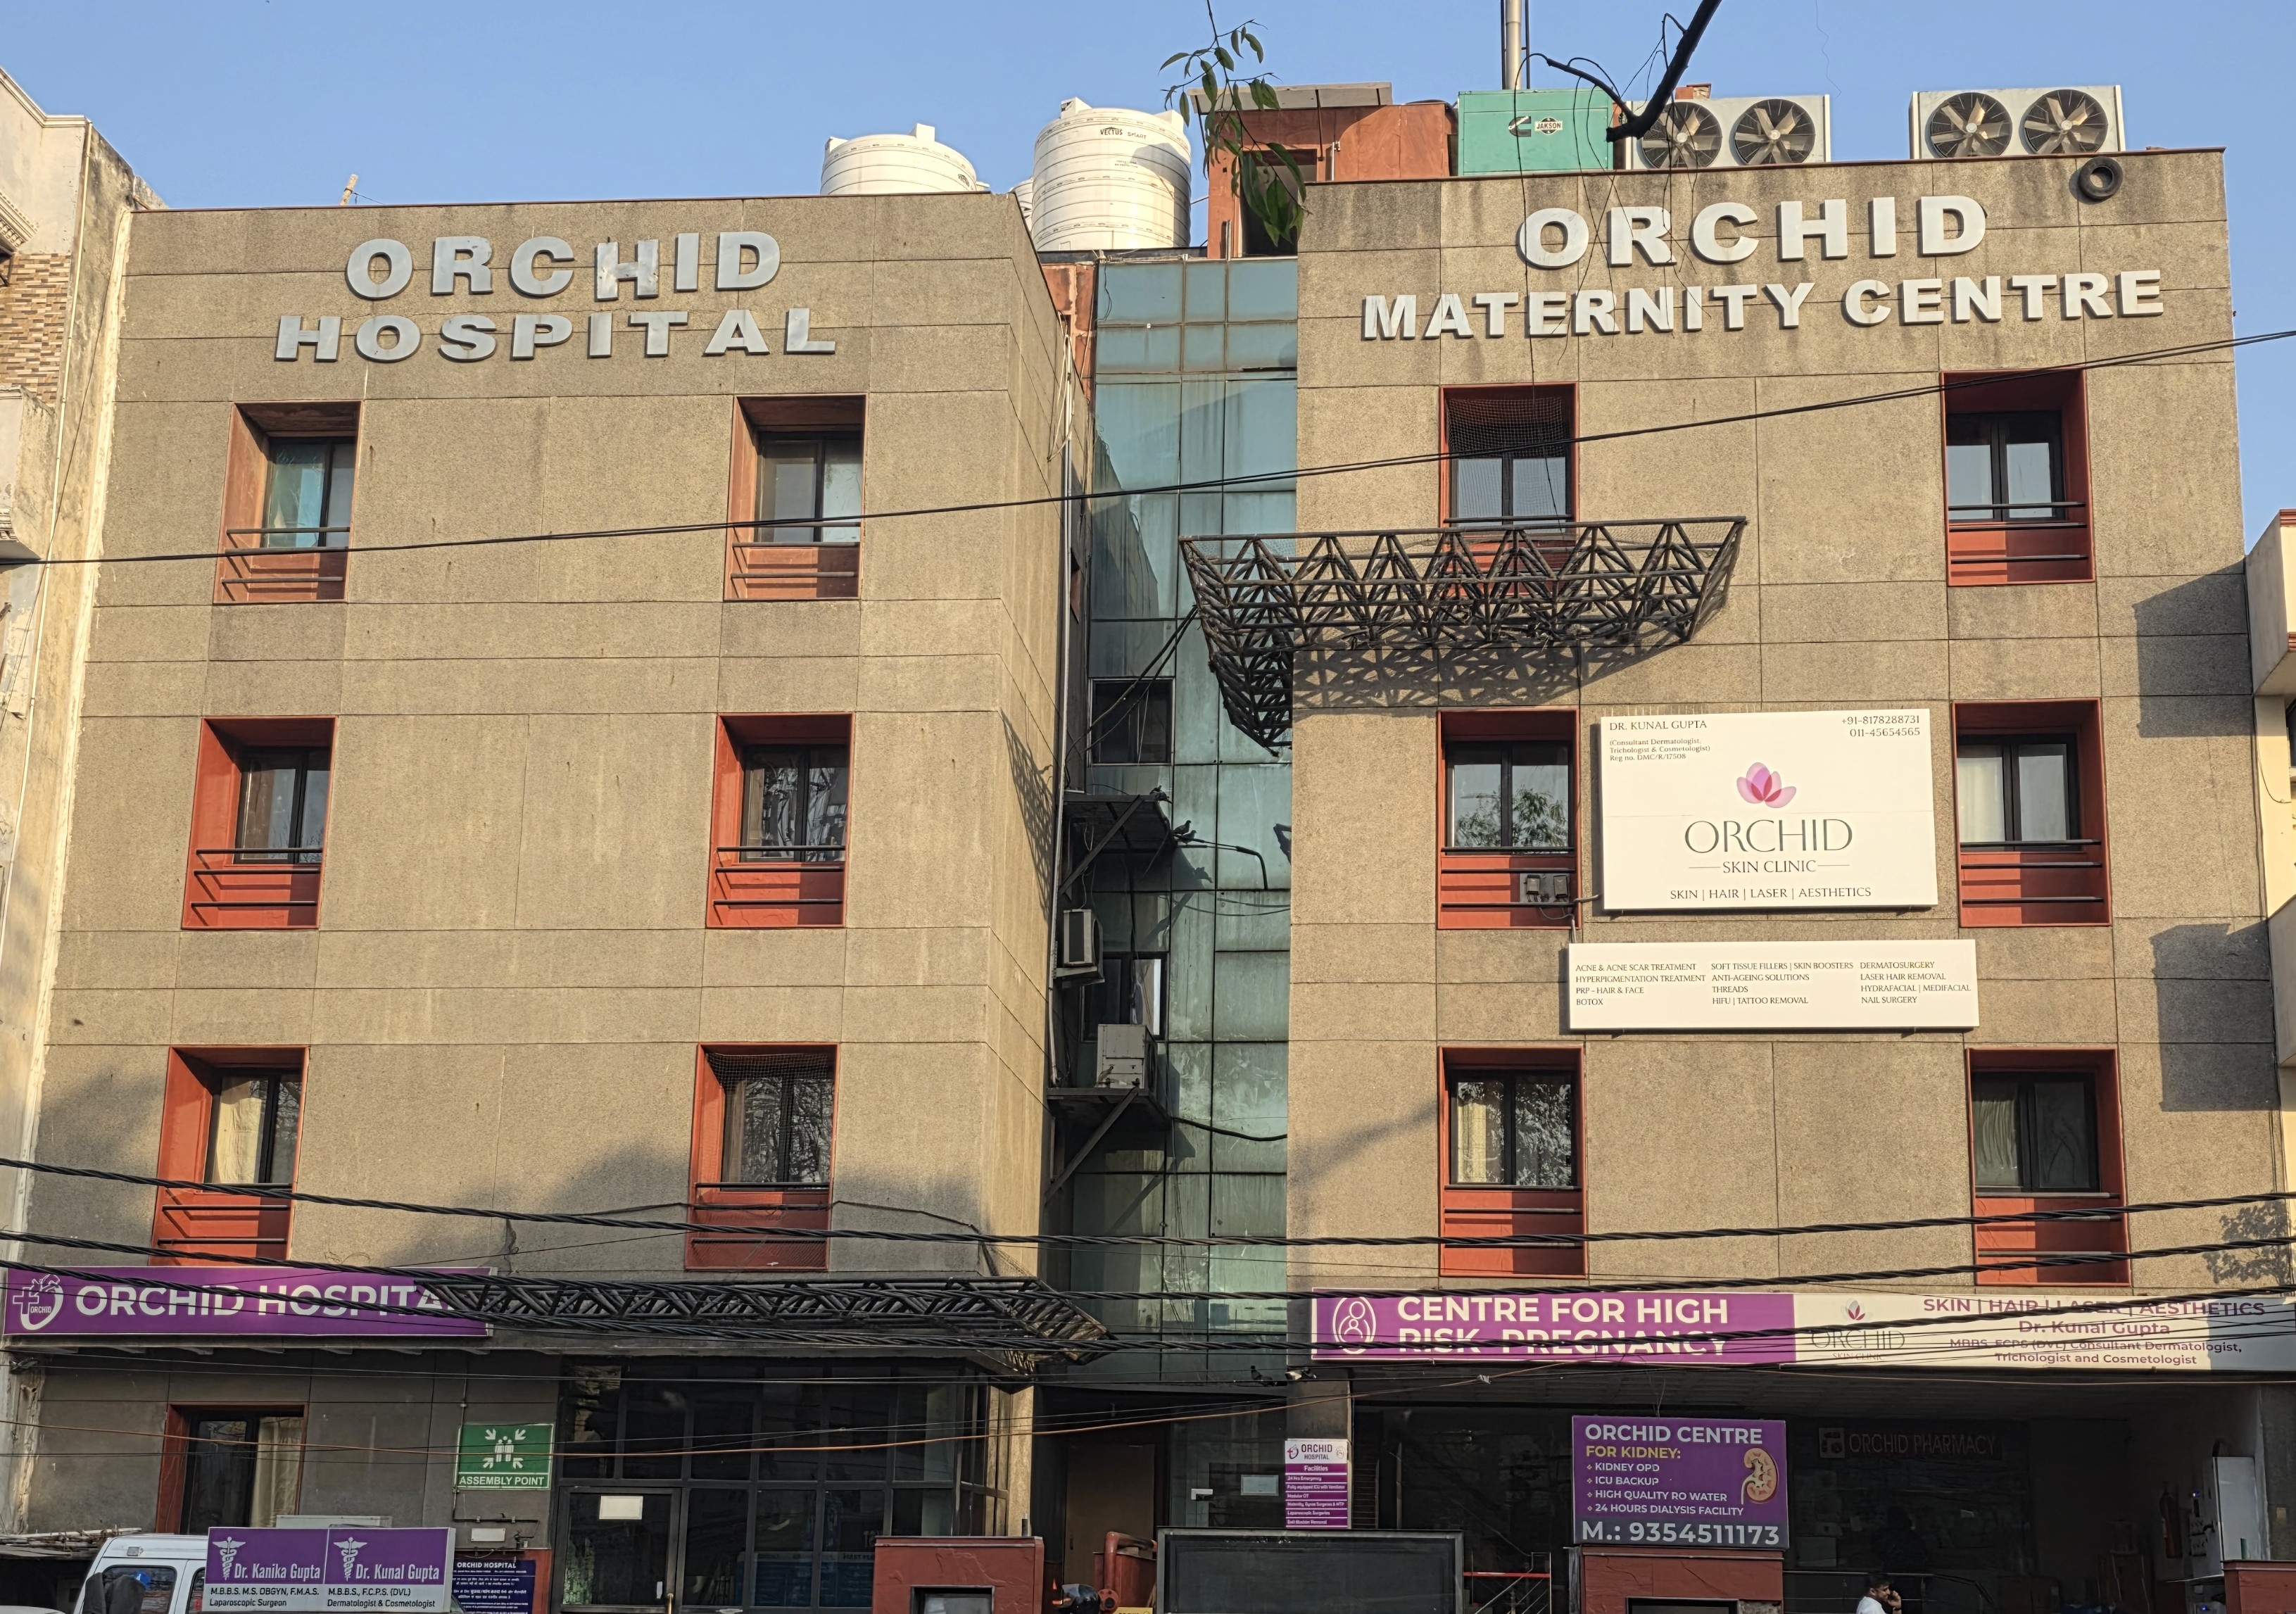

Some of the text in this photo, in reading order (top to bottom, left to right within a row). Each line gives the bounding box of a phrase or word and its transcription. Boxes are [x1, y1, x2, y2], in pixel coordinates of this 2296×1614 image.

[1100, 127, 1123, 136] VECTUS
[1517, 196, 1987, 270] ORCHID
[346, 231, 781, 300] ORCHID
[1361, 270, 2164, 341] MATERNITY CENTRE
[274, 308, 836, 362] HOSPITAL
[1610, 720, 1708, 731] DR. KUNAL GUPTA
[1841, 715, 1919, 725] +91-8178288731
[1850, 727, 1920, 737] 011-45654565
[1684, 819, 1853, 854] ORCHID
[1722, 860, 1817, 874] SKIN CLINIC
[1670, 888, 1871, 900] SKIN HAIR LASER AESTHETICS
[76, 1285, 457, 1316] ORCHID HOSPITA
[1924, 1299, 2038, 1313] SKIN HAIR
[1398, 1296, 1728, 1324] CENTRE FOR HIGH
[2139, 1301, 2265, 1316] AESTHETICS
[2019, 1320, 2171, 1337] Dr. Kunal Gupta
[1399, 1328, 1726, 1355] RISK PREGNANCY
[1812, 1330, 1905, 1349] ORCHID
[2071, 1342, 2140, 1350] Consultant
[2145, 1342, 2242, 1353] Dermatologist,
[1996, 1353, 2197, 1366] Trichologist and Cosmetologist
[1585, 1424, 1763, 1444] ORCHID CENTRE
[1301, 1444, 1332, 1453] ORCHID
[1849, 1434, 1996, 1455] ORCHID PHARMACY
[1586, 1446, 1681, 1459] FOR KIDNEY:
[1595, 1463, 1660, 1472] KIDNEY OPD
[459, 1476, 545, 1485] ASSEMBLY POINT
[1595, 1476, 1659, 1486] ICU BACKUP
[1596, 1490, 1727, 1501] HIGH QUALITY RO WATER
[1595, 1503, 1744, 1515] 24 HOURS DIALYSIS FACILITY
[1582, 1521, 1779, 1545] M.: 9354511173
[234, 1563, 320, 1582] Dr. Kanika Gupta
[355, 1564, 440, 1582] Dr. Kunal Gupta
[328, 1588, 360, 1596] M.B.B.S.,
[390, 1588, 411, 1596] (DVL)
[210, 1599, 287, 1608] Laparoscopic Surgeon
[327, 1599, 377, 1608] Dermatologist
[385, 1599, 435, 1608] Cosmetologist
